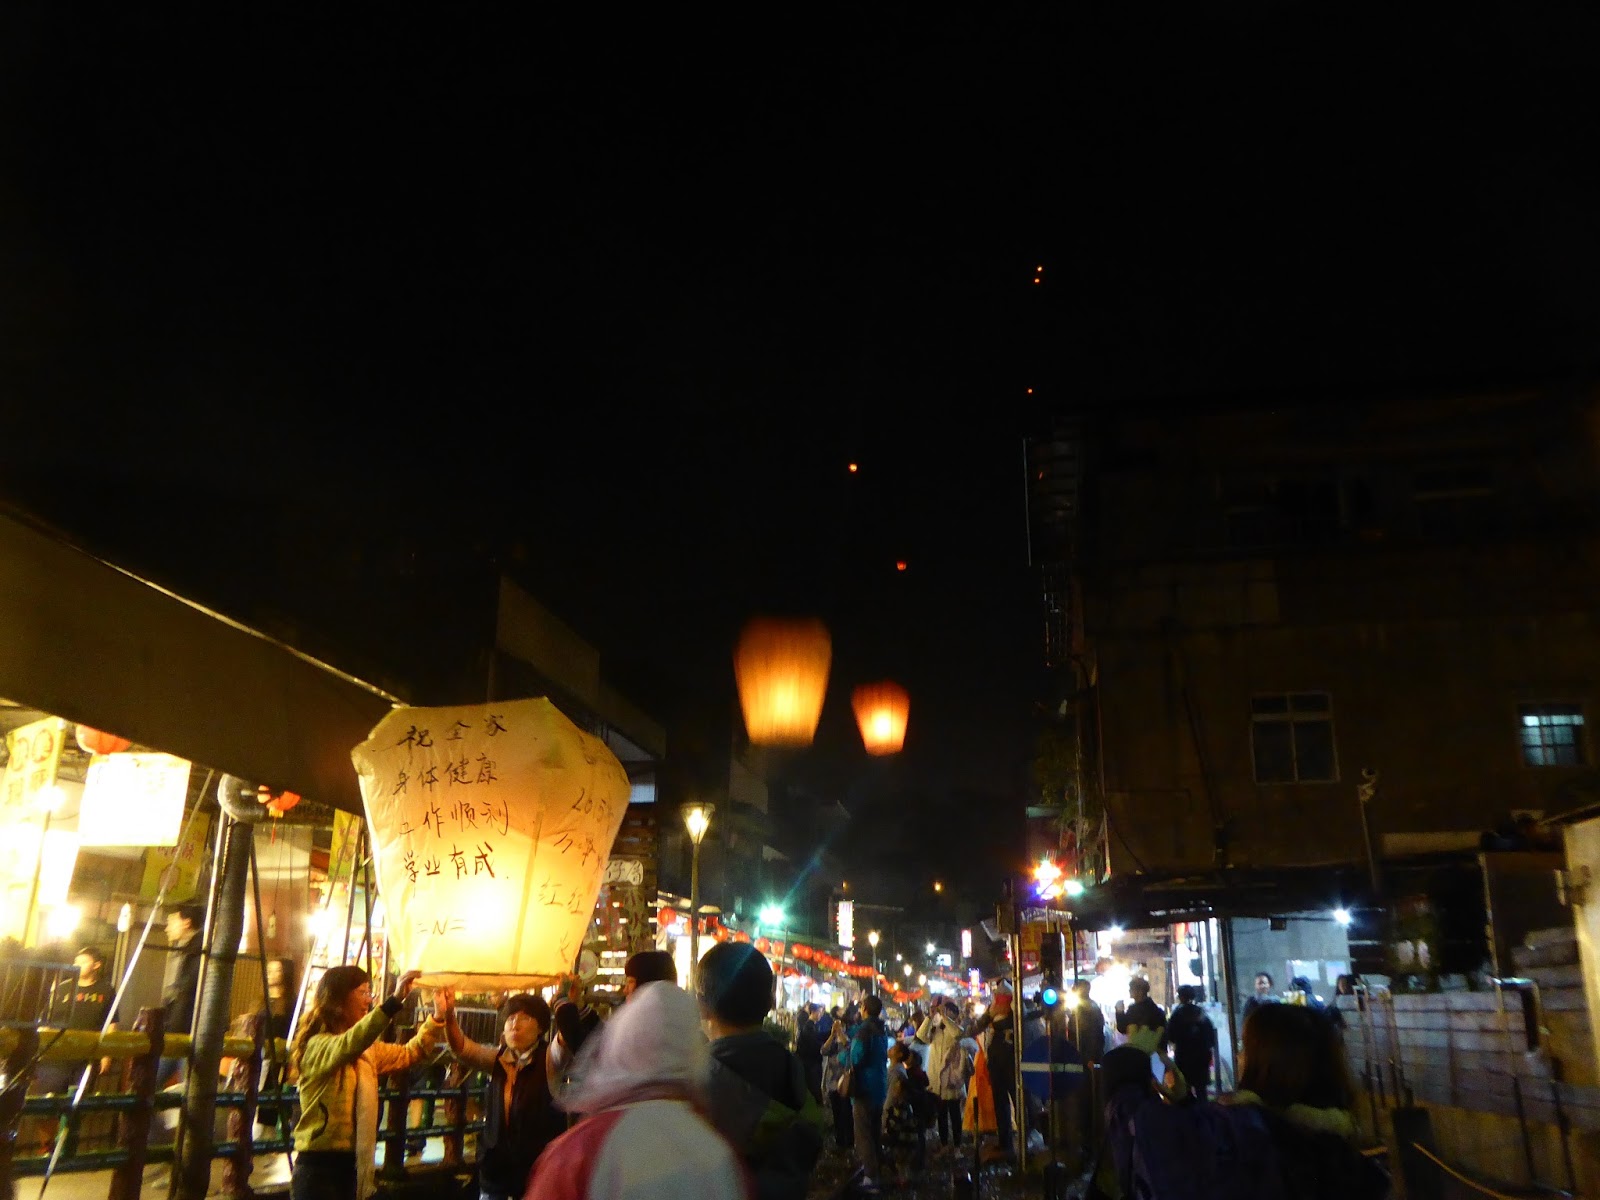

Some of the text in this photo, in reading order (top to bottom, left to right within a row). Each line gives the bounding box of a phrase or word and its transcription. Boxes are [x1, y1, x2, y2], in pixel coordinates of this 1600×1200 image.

[395, 713, 507, 763] 祝全家
[392, 752, 498, 796] 身体健康
[399, 799, 510, 839] 工作顺利
[403, 841, 495, 883] 学业有成
